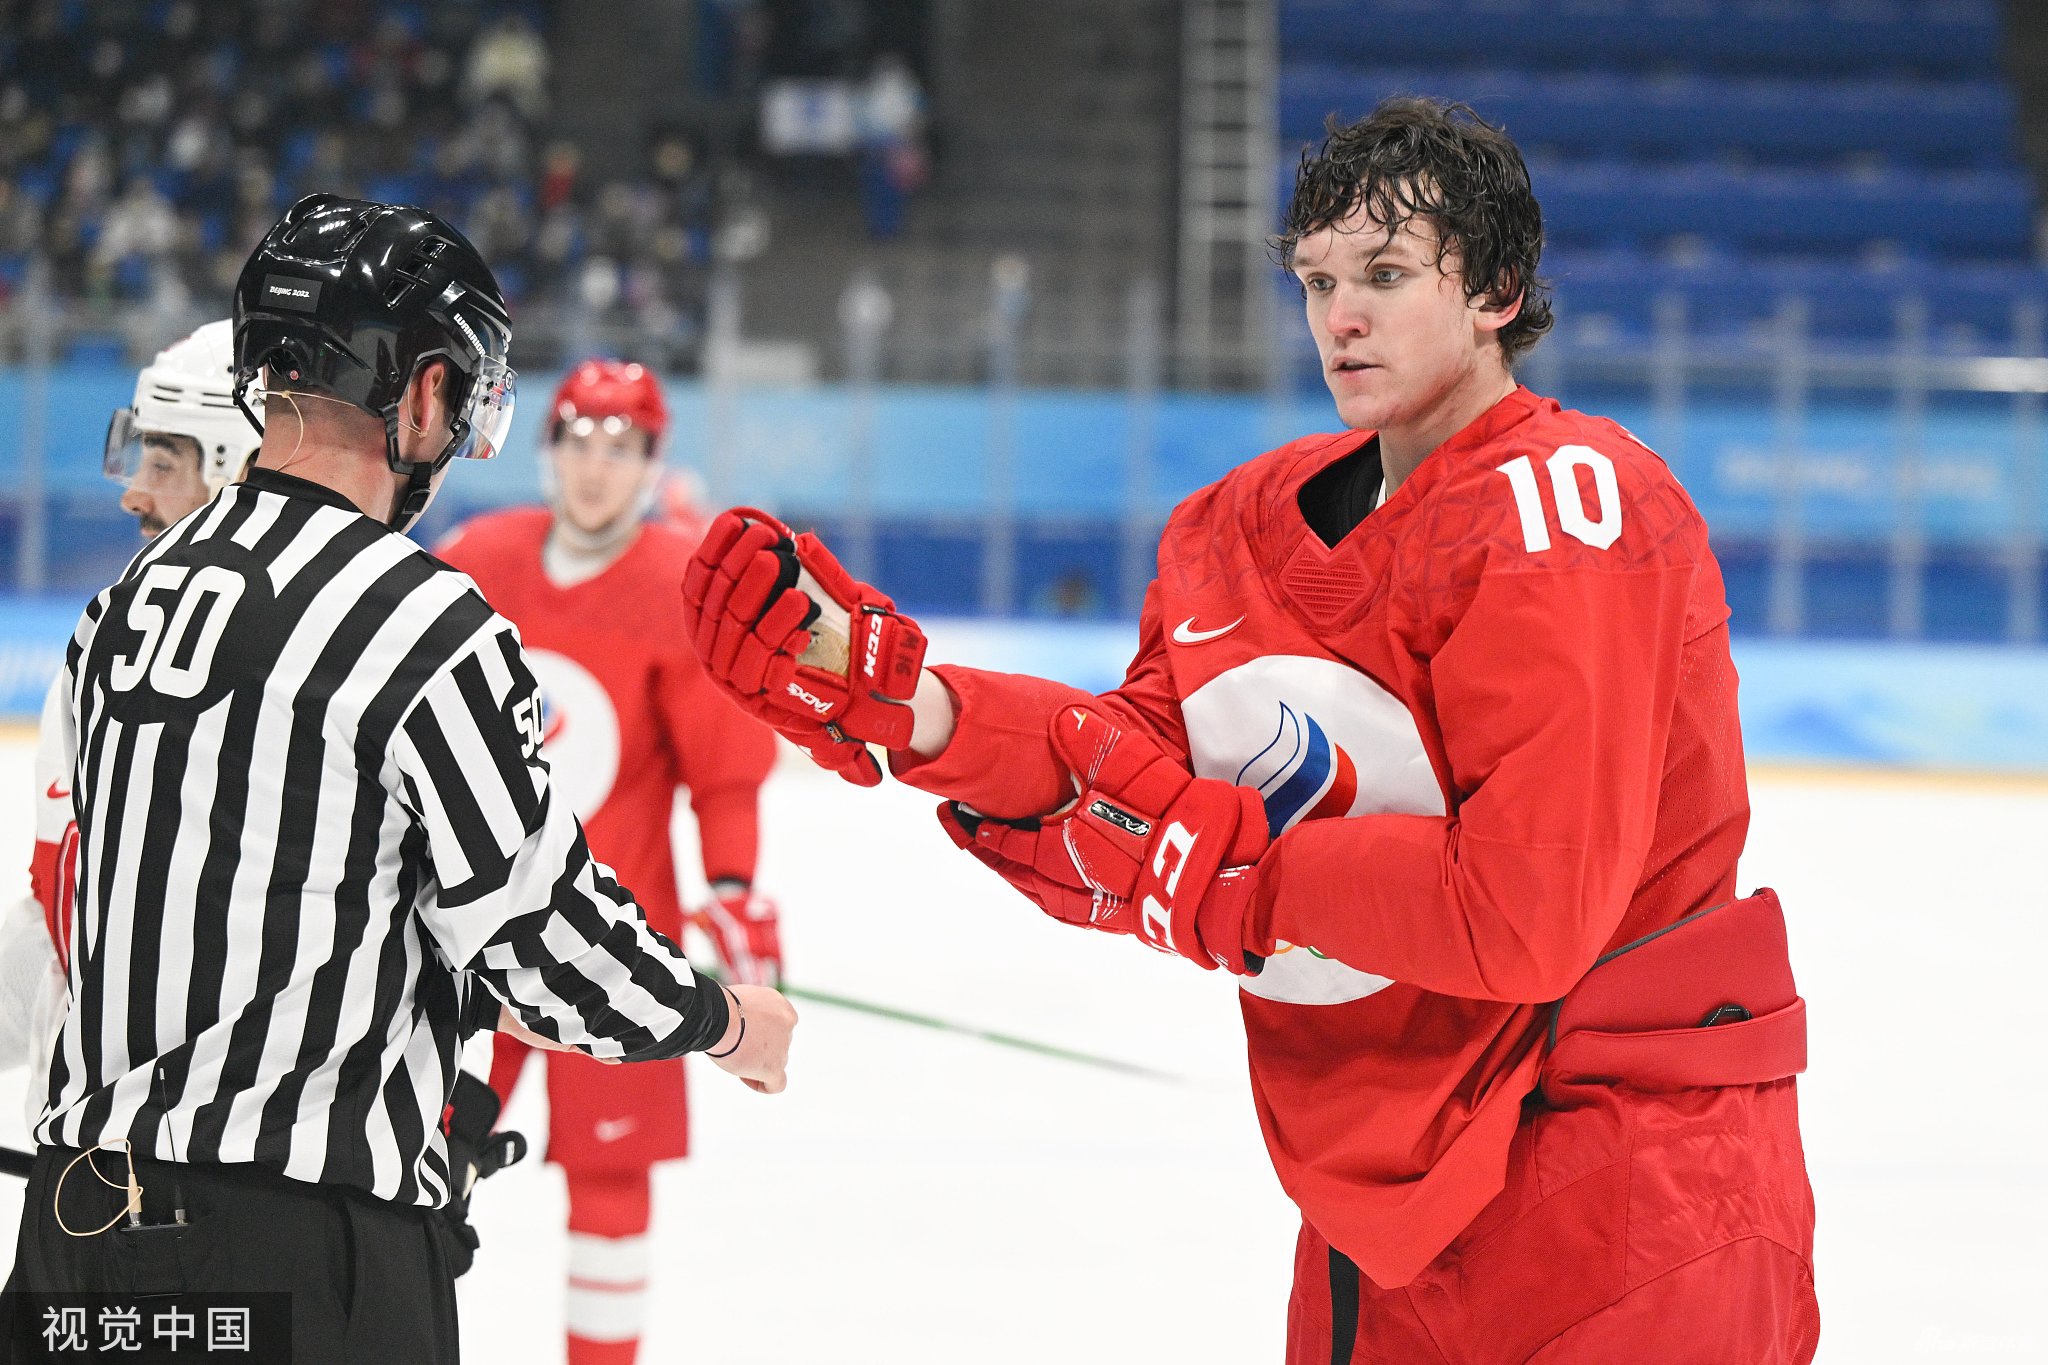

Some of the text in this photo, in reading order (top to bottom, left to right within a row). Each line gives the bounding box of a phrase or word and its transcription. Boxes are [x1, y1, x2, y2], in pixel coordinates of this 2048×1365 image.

[269, 285, 310, 298] BEIJING 2022
[453, 313, 486, 356] WARRIOR
[1496, 445, 1622, 553] 10
[110, 564, 246, 699] 50
[863, 613, 883, 678] CCM
[512, 686, 545, 759] 50
[1141, 820, 1199, 956] CC
